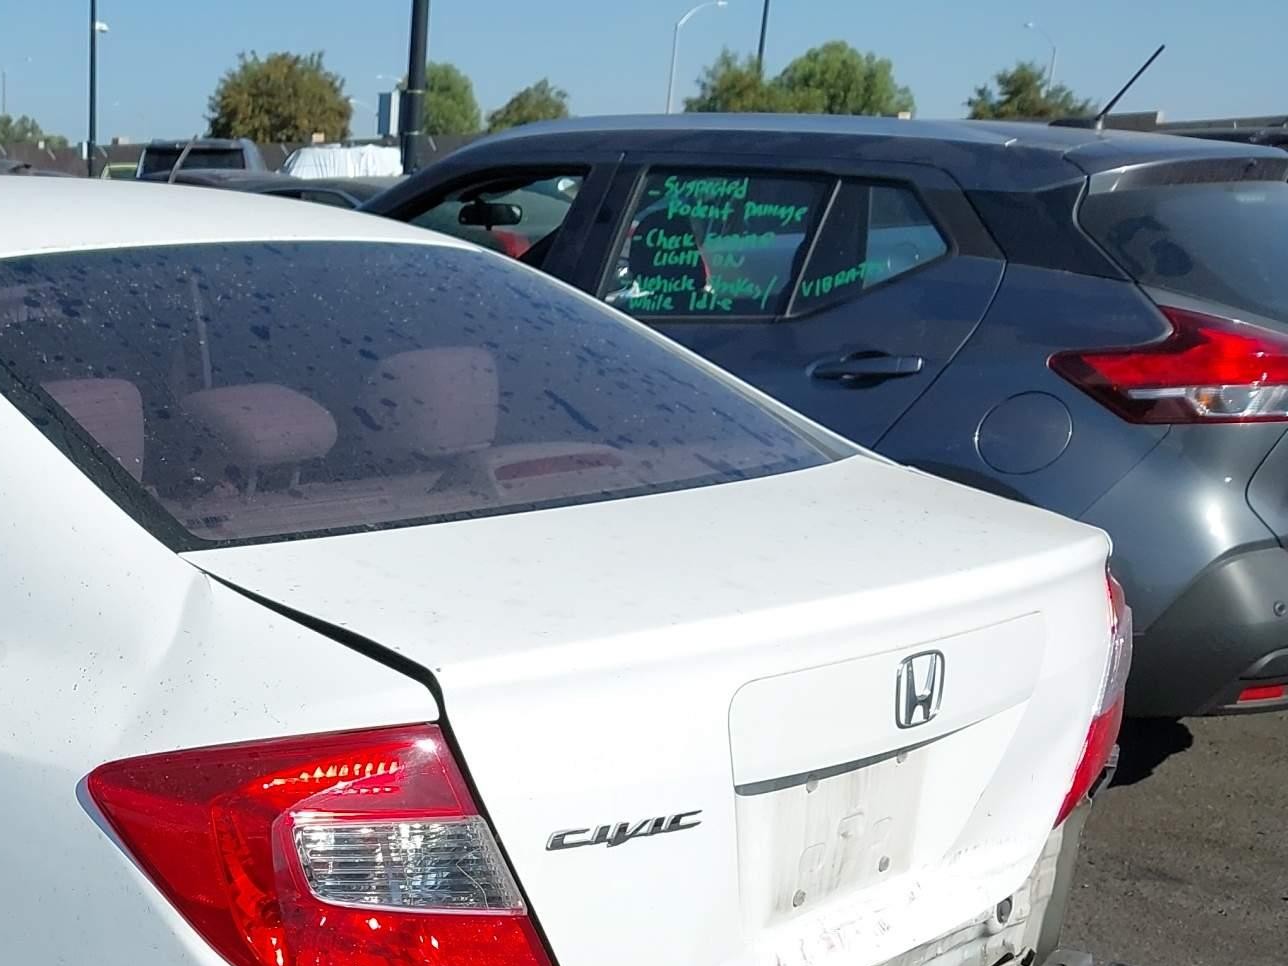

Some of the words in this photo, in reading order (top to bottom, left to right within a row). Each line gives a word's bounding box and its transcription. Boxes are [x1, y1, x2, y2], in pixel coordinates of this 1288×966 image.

[667, 201, 734, 220] Rodent
[646, 229, 695, 249] Check
[546, 809, 703, 851] CIVIC
